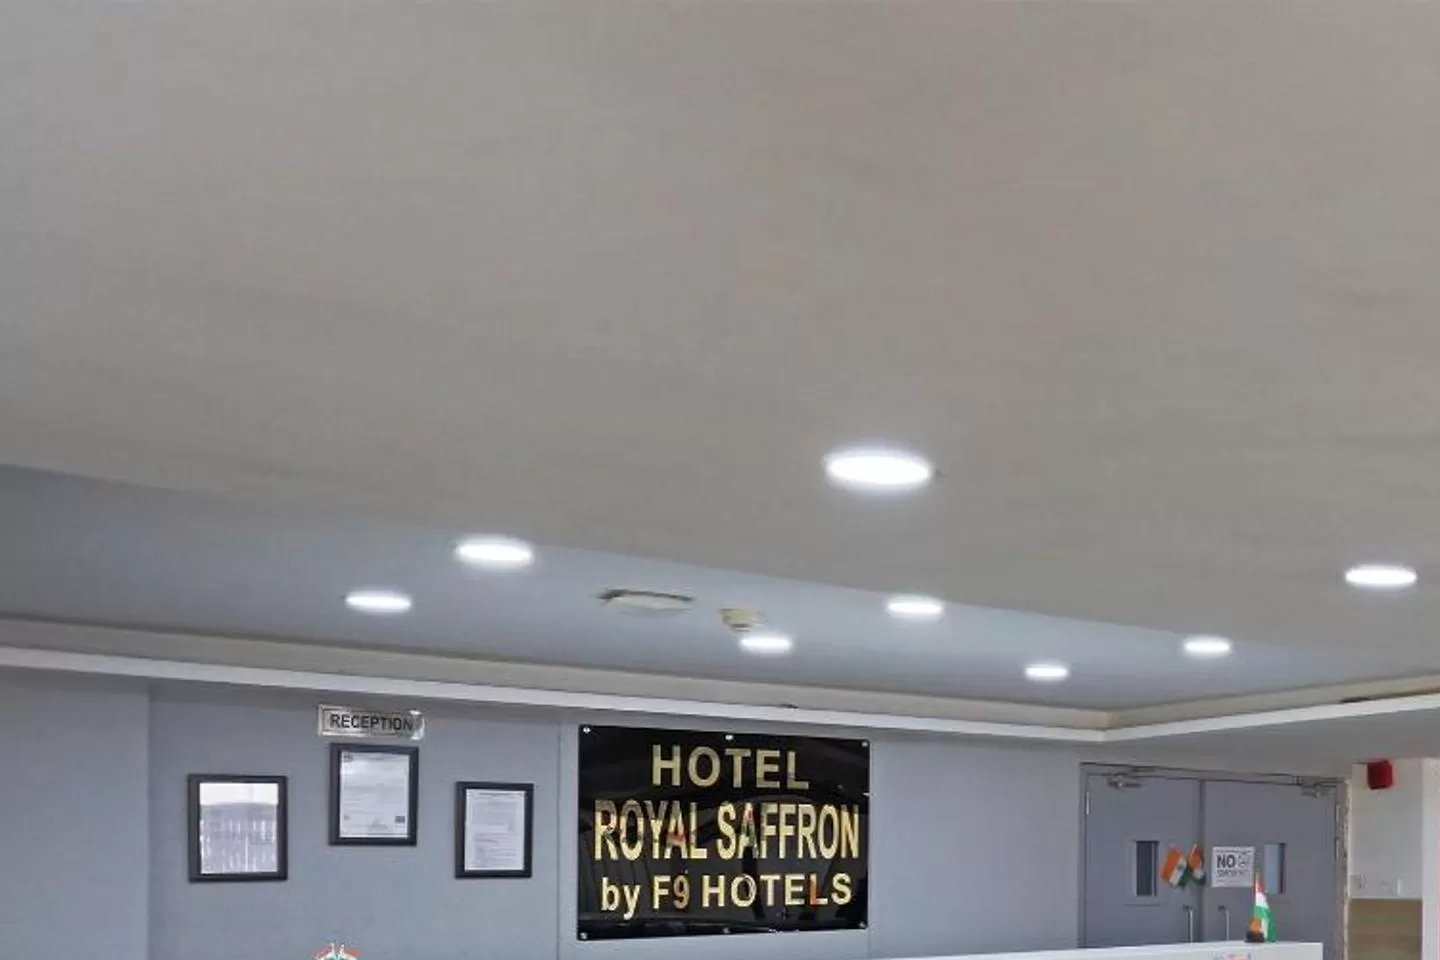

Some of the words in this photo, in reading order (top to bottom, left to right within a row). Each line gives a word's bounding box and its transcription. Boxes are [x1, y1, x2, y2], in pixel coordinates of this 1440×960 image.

[329, 713, 414, 730] RECEPTION
[652, 745, 809, 789] HOTEL
[595, 800, 707, 860] ROYAL
[717, 801, 859, 860] SAFFRON
[1216, 854, 1235, 868] NO
[601, 877, 641, 920] by
[653, 874, 690, 909] F9
[702, 873, 852, 907] HOTELS
